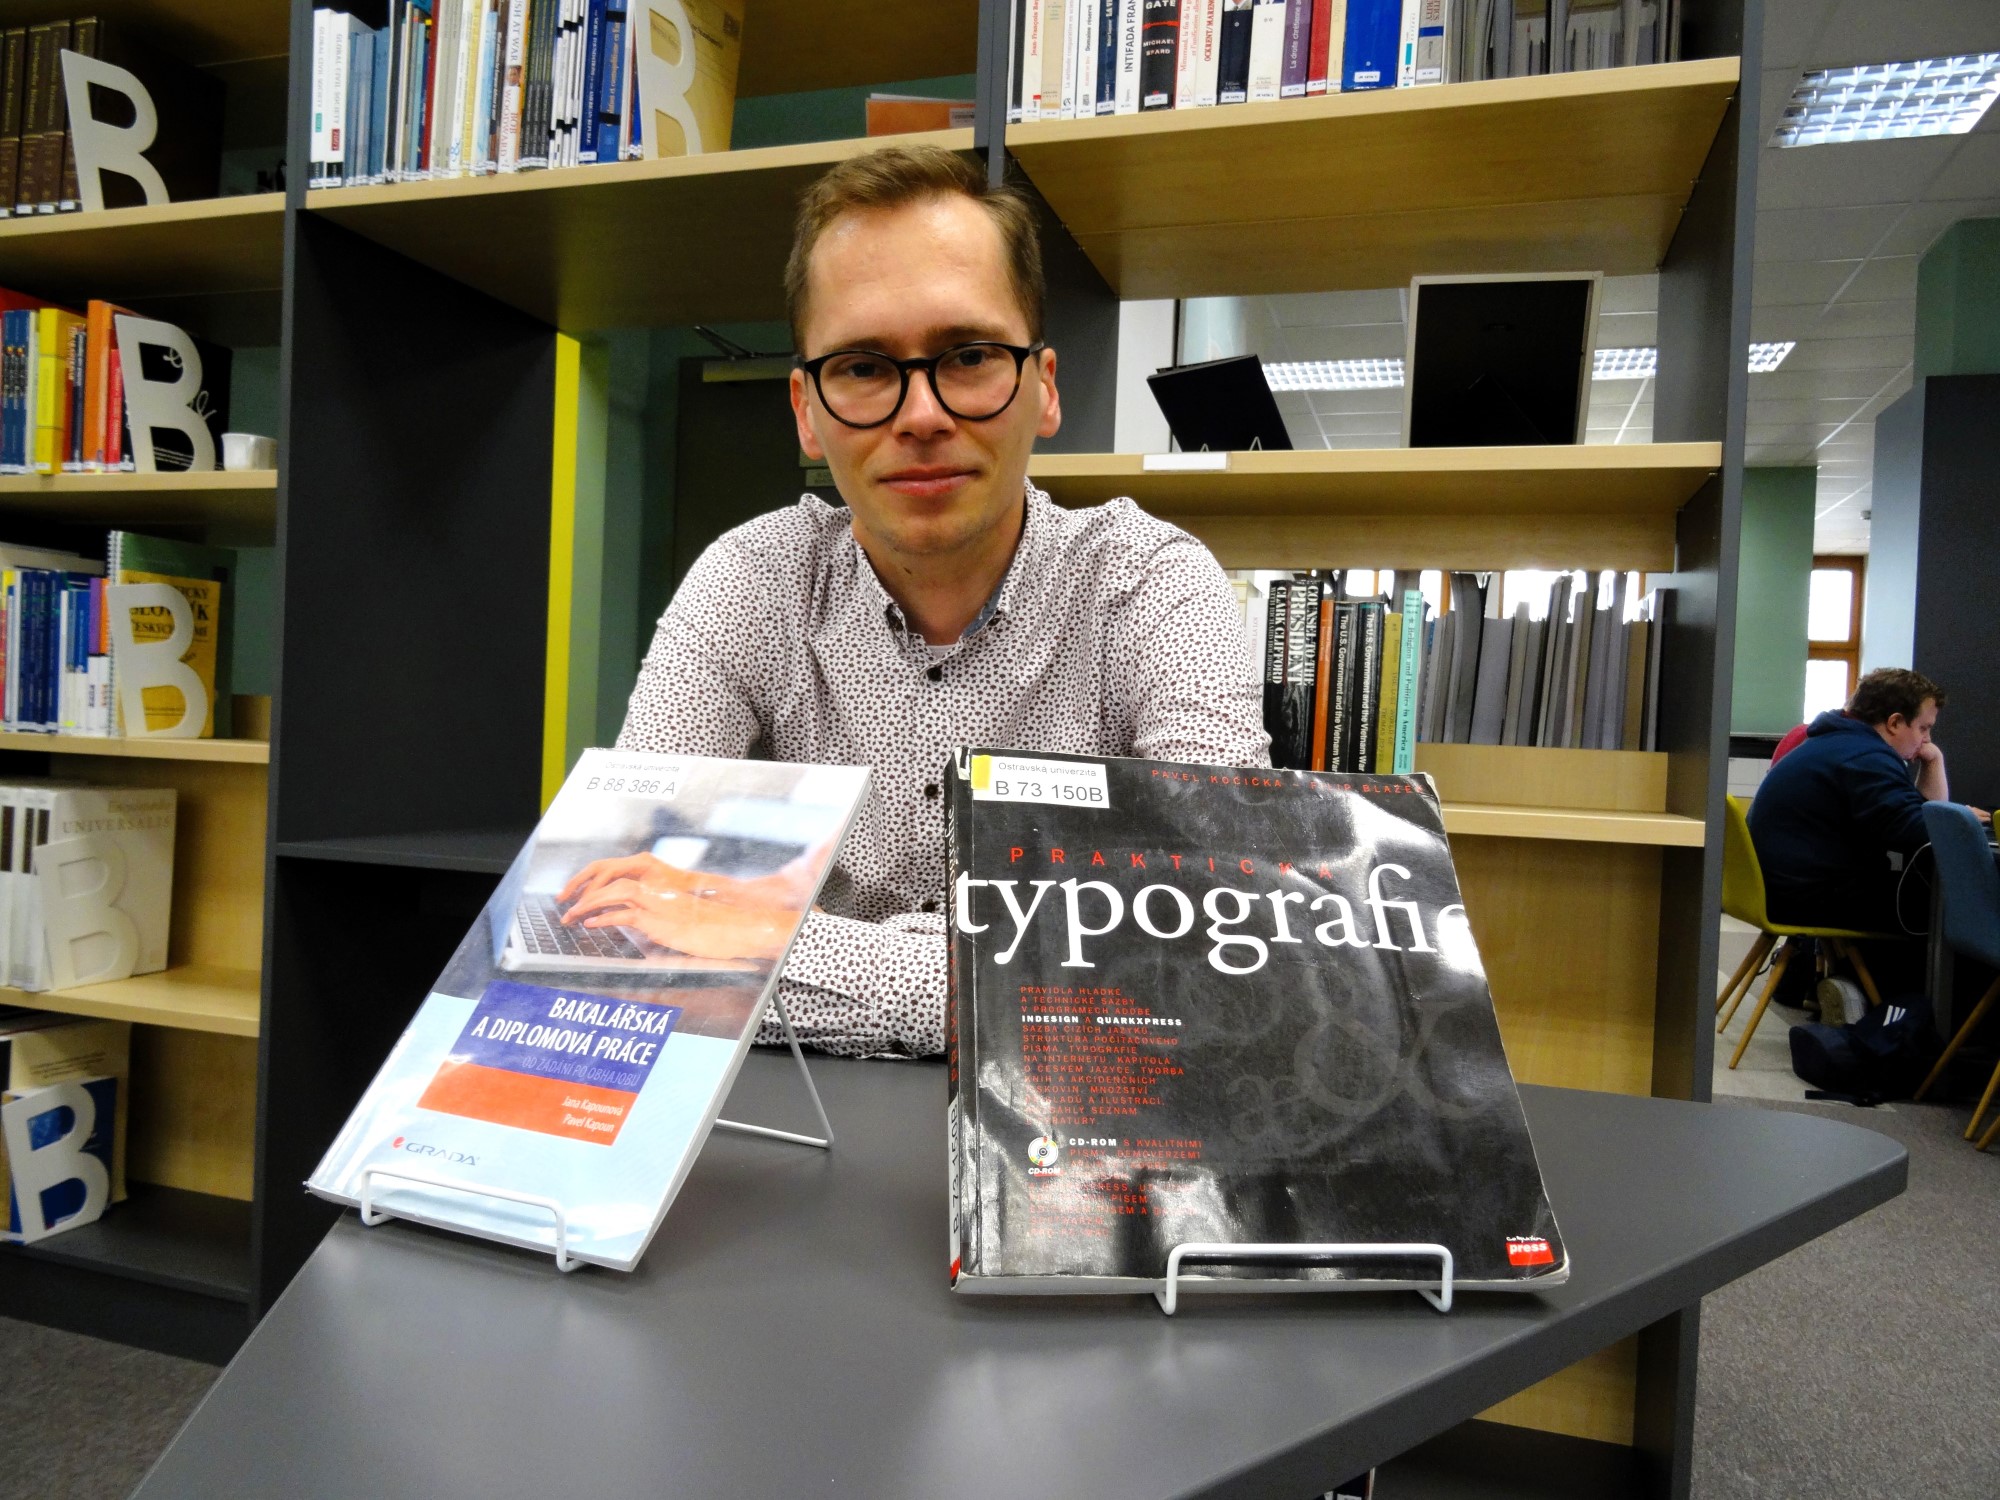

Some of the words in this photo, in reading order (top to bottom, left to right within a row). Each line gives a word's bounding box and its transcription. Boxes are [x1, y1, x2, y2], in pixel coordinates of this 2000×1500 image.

[1145, 0, 1176, 10] GATE
[1291, 7, 1301, 40] chrétienne
[510, 37, 520, 61] WAR
[1124, 26, 1136, 73] INTIFADA
[1143, 39, 1175, 47] MICHAEL
[1290, 41, 1298, 60] droite
[509, 112, 519, 134] BOB
[1274, 586, 1287, 626] CLARK
[1305, 586, 1319, 641] COUNSEL
[1339, 614, 1349, 630] The
[1366, 613, 1375, 628] The
[1286, 585, 1307, 686] PRESIDENT
[1338, 630, 1348, 647] U.S.
[1365, 628, 1374, 645] U.S.
[1406, 627, 1414, 660] Religion
[1271, 626, 1285, 684] CLIFFORD
[1304, 641, 1316, 658] TO
[1302, 658, 1316, 687] THE
[1335, 647, 1346, 695] Government
[1362, 645, 1372, 694] Government
[1405, 662, 1413, 676] and
[1404, 678, 1412, 706] Politics
[1335, 695, 1344, 710] and
[1361, 694, 1370, 709] and
[1334, 710, 1343, 723] the
[1360, 709, 1369, 722] the
[1332, 724, 1342, 756] Vietnam
[1358, 723, 1368, 755] Vietnam
[1400, 719, 1409, 751] America
[998, 762, 1048, 773] Ostravská
[1050, 766, 1097, 777] univerzita
[1331, 756, 1340, 772] War
[1358, 755, 1366, 772] War
[1151, 769, 1200, 783] PAVEL
[586, 777, 601, 790] B
[603, 778, 623, 792] 88
[627, 779, 661, 794] 386
[662, 782, 676, 795] A
[995, 780, 1010, 796] B
[1017, 781, 1042, 797] 73
[1052, 784, 1103, 802] 150B
[944, 804, 958, 927] typografie
[1020, 986, 1073, 995] PRAVIDLA
[1021, 996, 1027, 1004] A
[1100, 997, 1136, 1006] SAZBY
[548, 996, 673, 1036] BAKALÁŘSKÁ
[1021, 1015, 1079, 1023] INDESIGN
[1033, 1006, 1109, 1015] PROGRAMECH
[1114, 1007, 1151, 1016] ADOBE
[1022, 1025, 1058, 1033] SAZBA
[470, 1016, 490, 1037] A
[487, 1017, 596, 1056] DIPLOMOVÁ
[594, 1035, 657, 1066] PRÁCE
[1023, 1035, 1088, 1044] STRUKTURA
[1069, 1045, 1138, 1054] TYPOGRAFIE
[536, 1058, 575, 1074] ZADÁNÍ
[572, 1063, 588, 1078] PO
[1024, 1055, 1038, 1063] NA
[1117, 1056, 1171, 1065] KAPITOLA
[1024, 1065, 1031, 1073] O
[1140, 1067, 1185, 1076] TVORBA
[1058, 1075, 1065, 1083] A
[562, 1095, 581, 1107] Jana
[580, 1098, 625, 1117] Kapounová
[1088, 1096, 1095, 1104] A
[1091, 1106, 1137, 1115] SEZNAM
[562, 1113, 585, 1125] Pavel
[584, 1119, 616, 1133] Kapoun
[1069, 1137, 1117, 1147] CD-ROM
[1123, 1138, 1130, 1147] S
[405, 1141, 477, 1167] GRADA
[1117, 1149, 1202, 1159] DEMOVERZEMI
[1028, 1167, 1061, 1175] CD-ROM
[952, 1174, 959, 1208] 73
[1140, 1207, 1148, 1215] A
[1509, 1243, 1548, 1255] press
